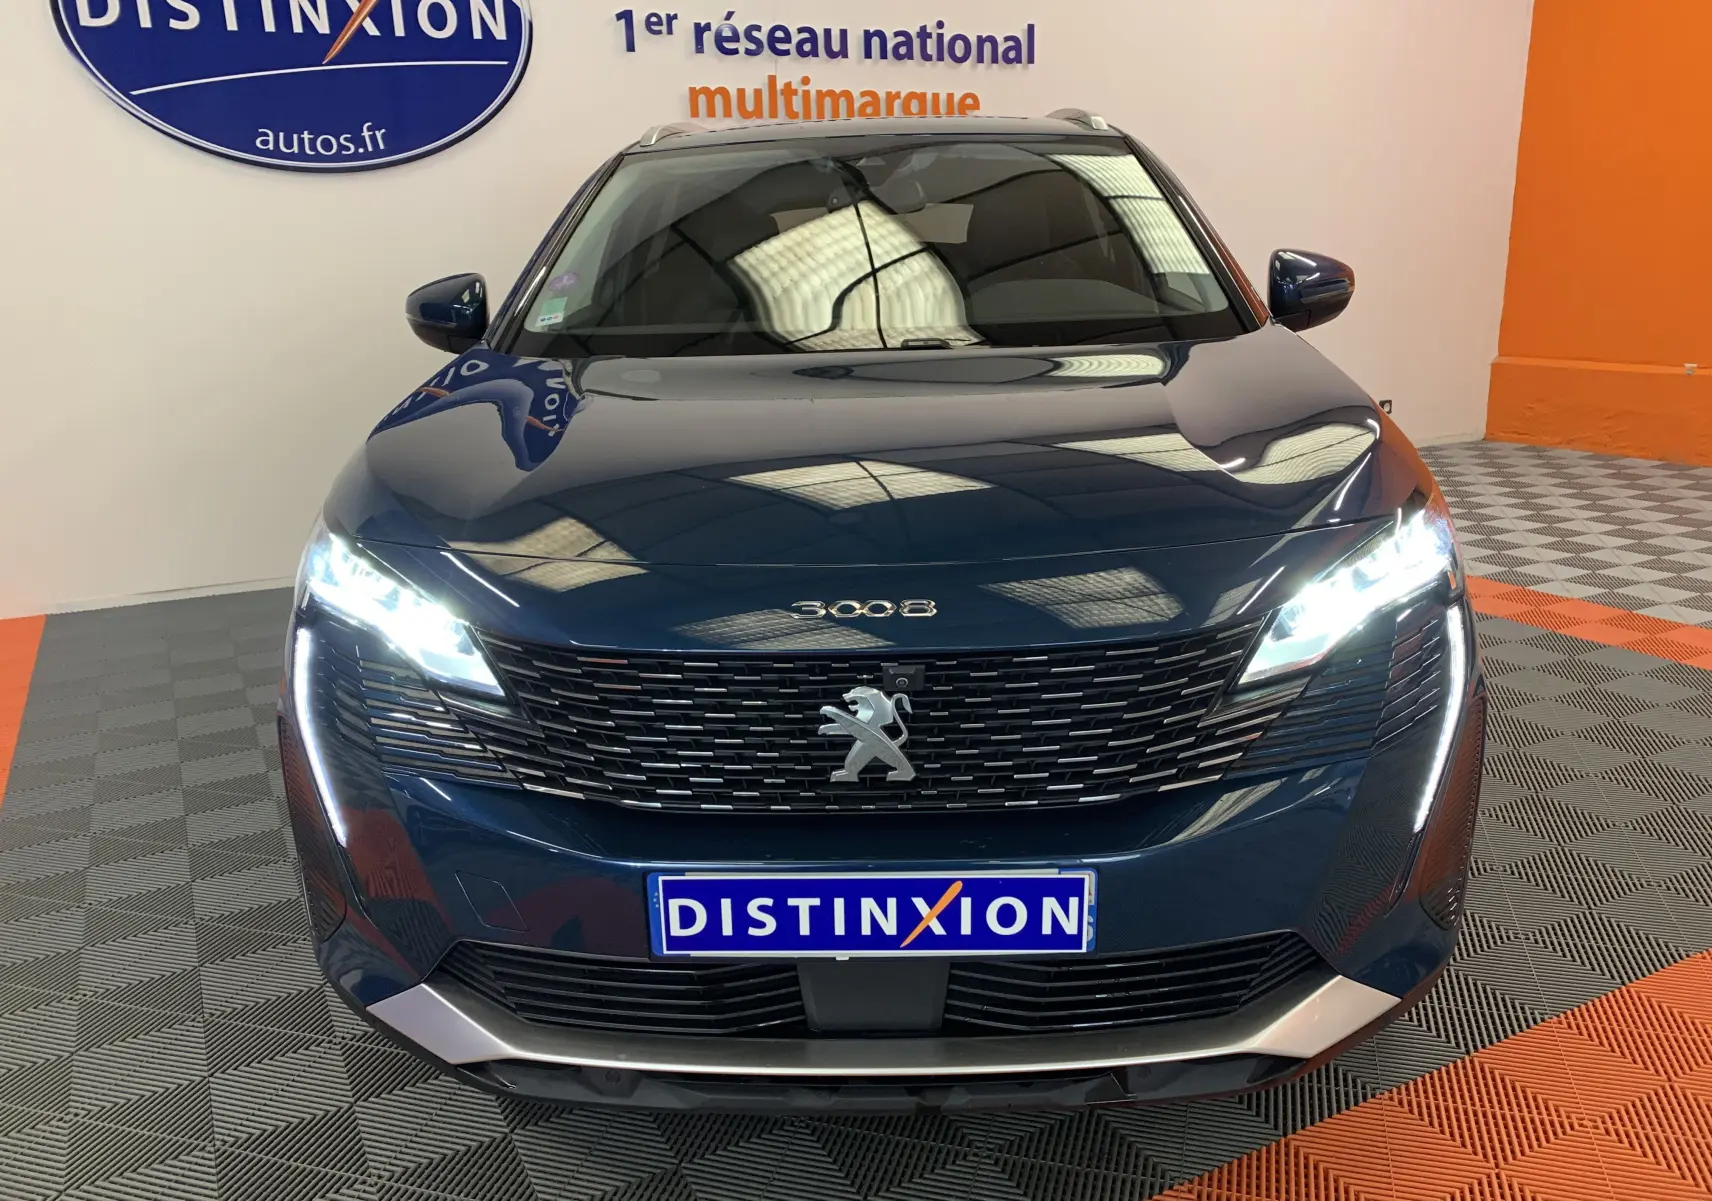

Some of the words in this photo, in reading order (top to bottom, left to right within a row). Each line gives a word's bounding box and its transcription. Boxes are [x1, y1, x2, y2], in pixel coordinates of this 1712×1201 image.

[76, 0, 508, 64] DISTINXION
[615, 9, 678, 52] 1er
[693, 10, 849, 59] réseau
[863, 20, 1036, 65] national
[688, 74, 980, 120] multimarque
[255, 122, 386, 155] autos.fr
[791, 599, 937, 618] 3008
[668, 880, 1079, 948] DISTINXION
